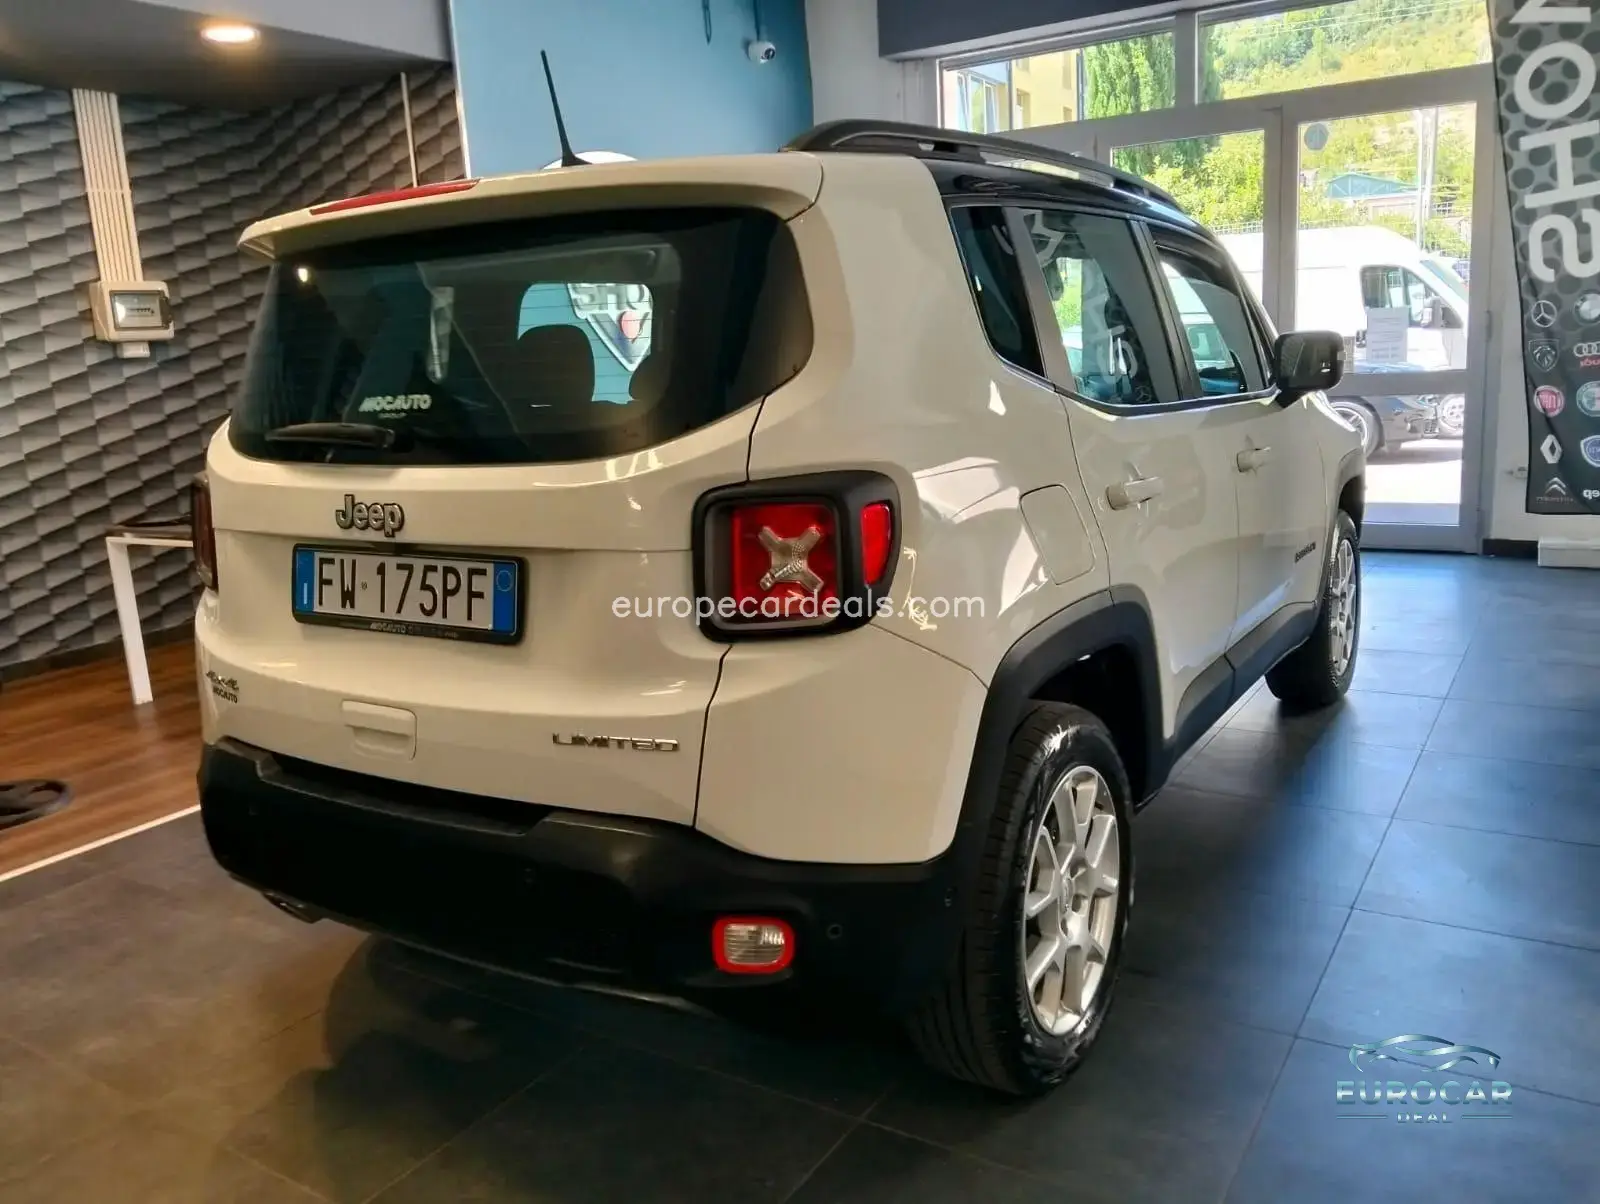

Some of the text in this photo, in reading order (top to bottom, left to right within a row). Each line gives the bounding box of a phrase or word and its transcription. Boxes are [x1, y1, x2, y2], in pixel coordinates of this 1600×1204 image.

[335, 493, 405, 538] Jeep
[317, 557, 488, 621] FW 175PF
[552, 732, 679, 752] LIMITED
